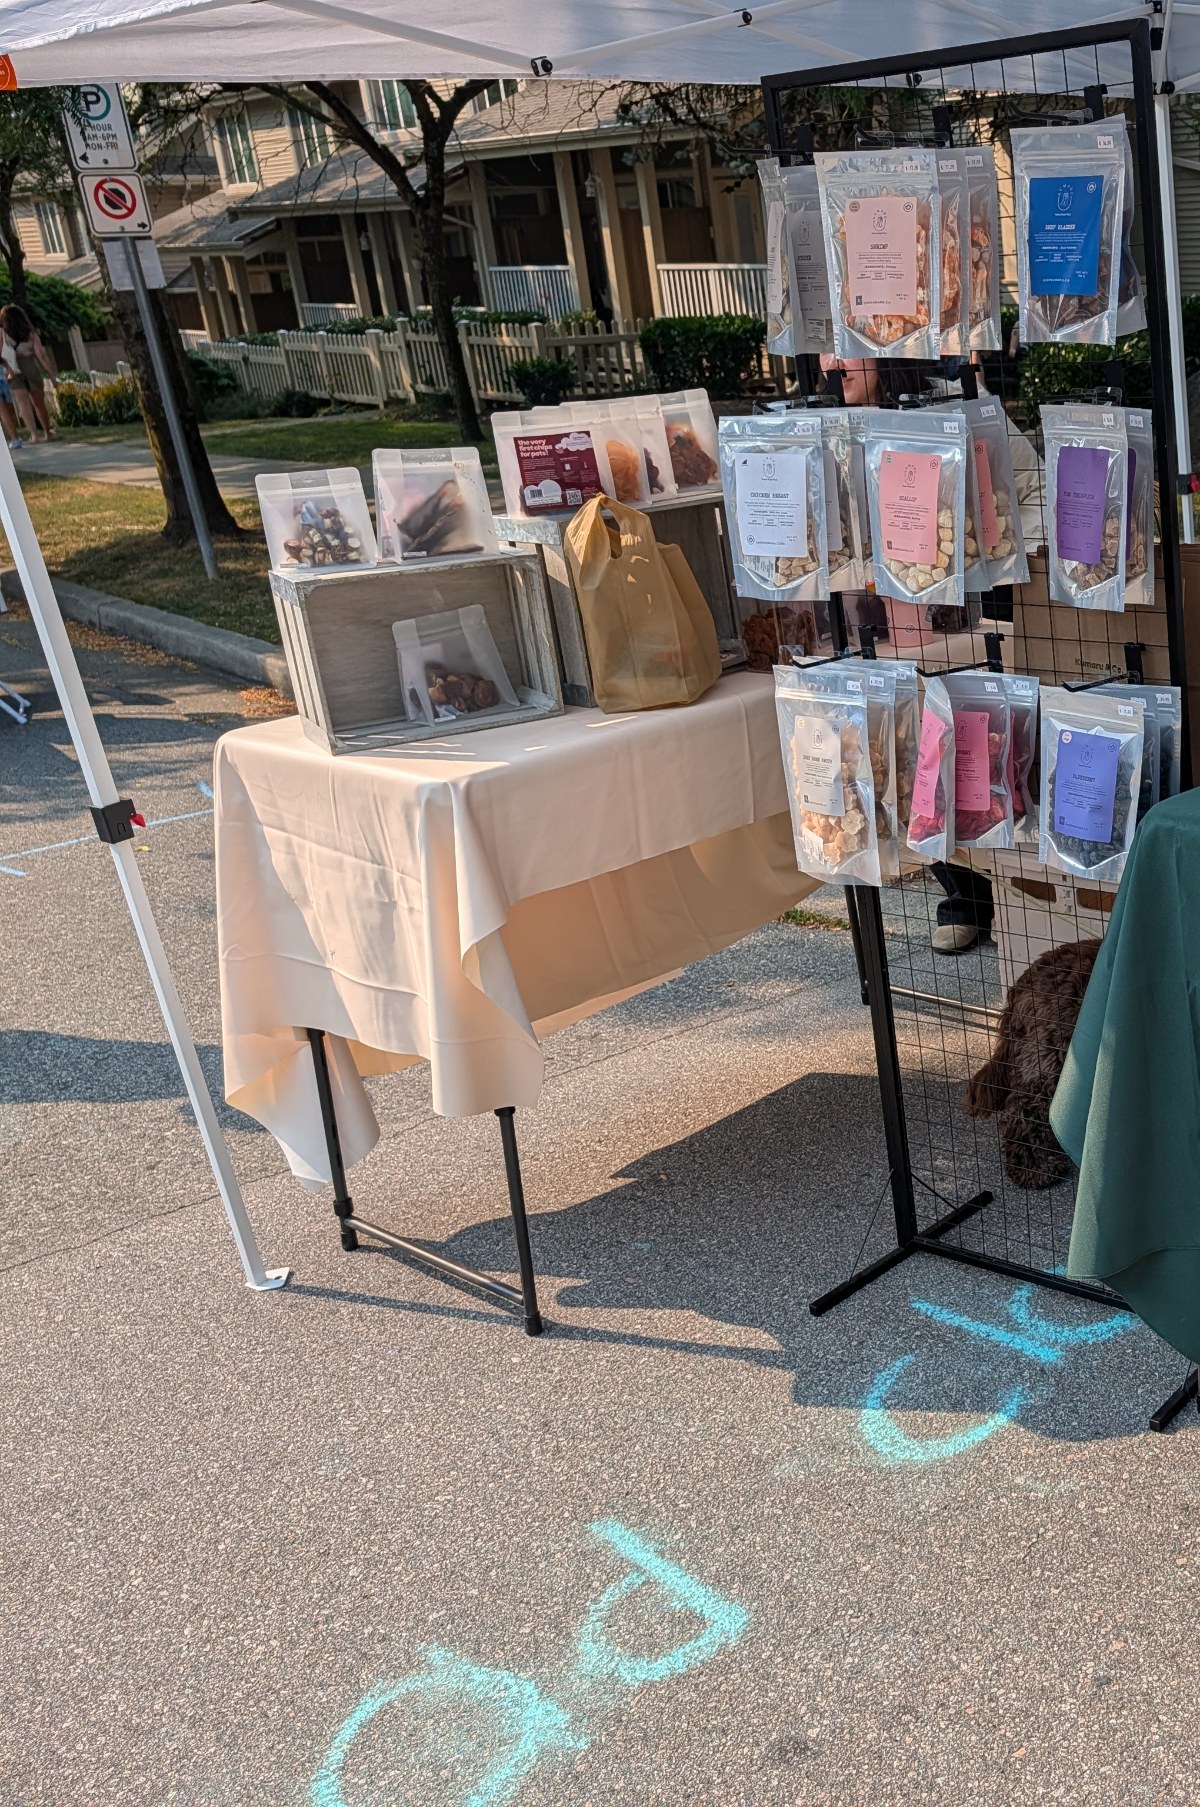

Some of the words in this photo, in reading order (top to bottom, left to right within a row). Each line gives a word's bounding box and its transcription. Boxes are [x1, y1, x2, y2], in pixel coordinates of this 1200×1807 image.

[81, 91, 101, 112] P
[83, 133, 118, 141] AM-6PM
[534, 444, 553, 452] chips
[530, 450, 549, 459] pets!
[1074, 657, 1104, 671] Kumaru
